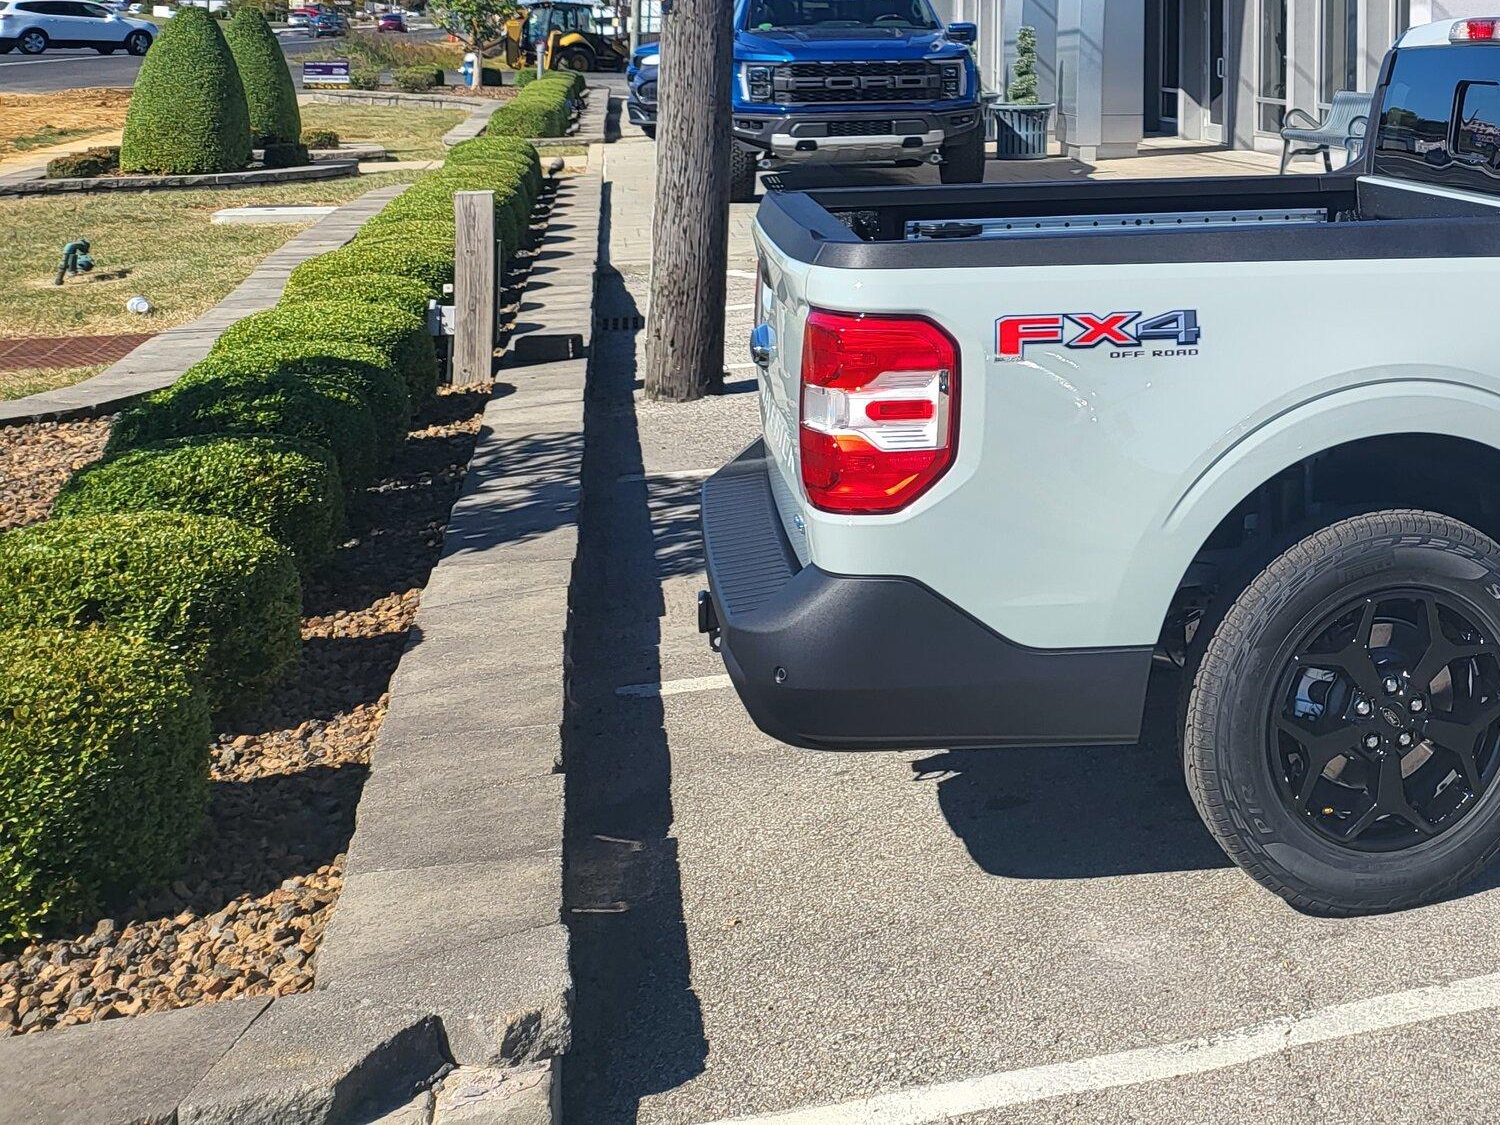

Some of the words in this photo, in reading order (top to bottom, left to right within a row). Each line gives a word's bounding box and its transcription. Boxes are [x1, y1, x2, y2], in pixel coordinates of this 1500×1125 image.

[787, 75, 930, 90] FORD
[994, 309, 1201, 359] FX4
[1110, 351, 1146, 359] OFF
[1152, 348, 1200, 358] ROAD
